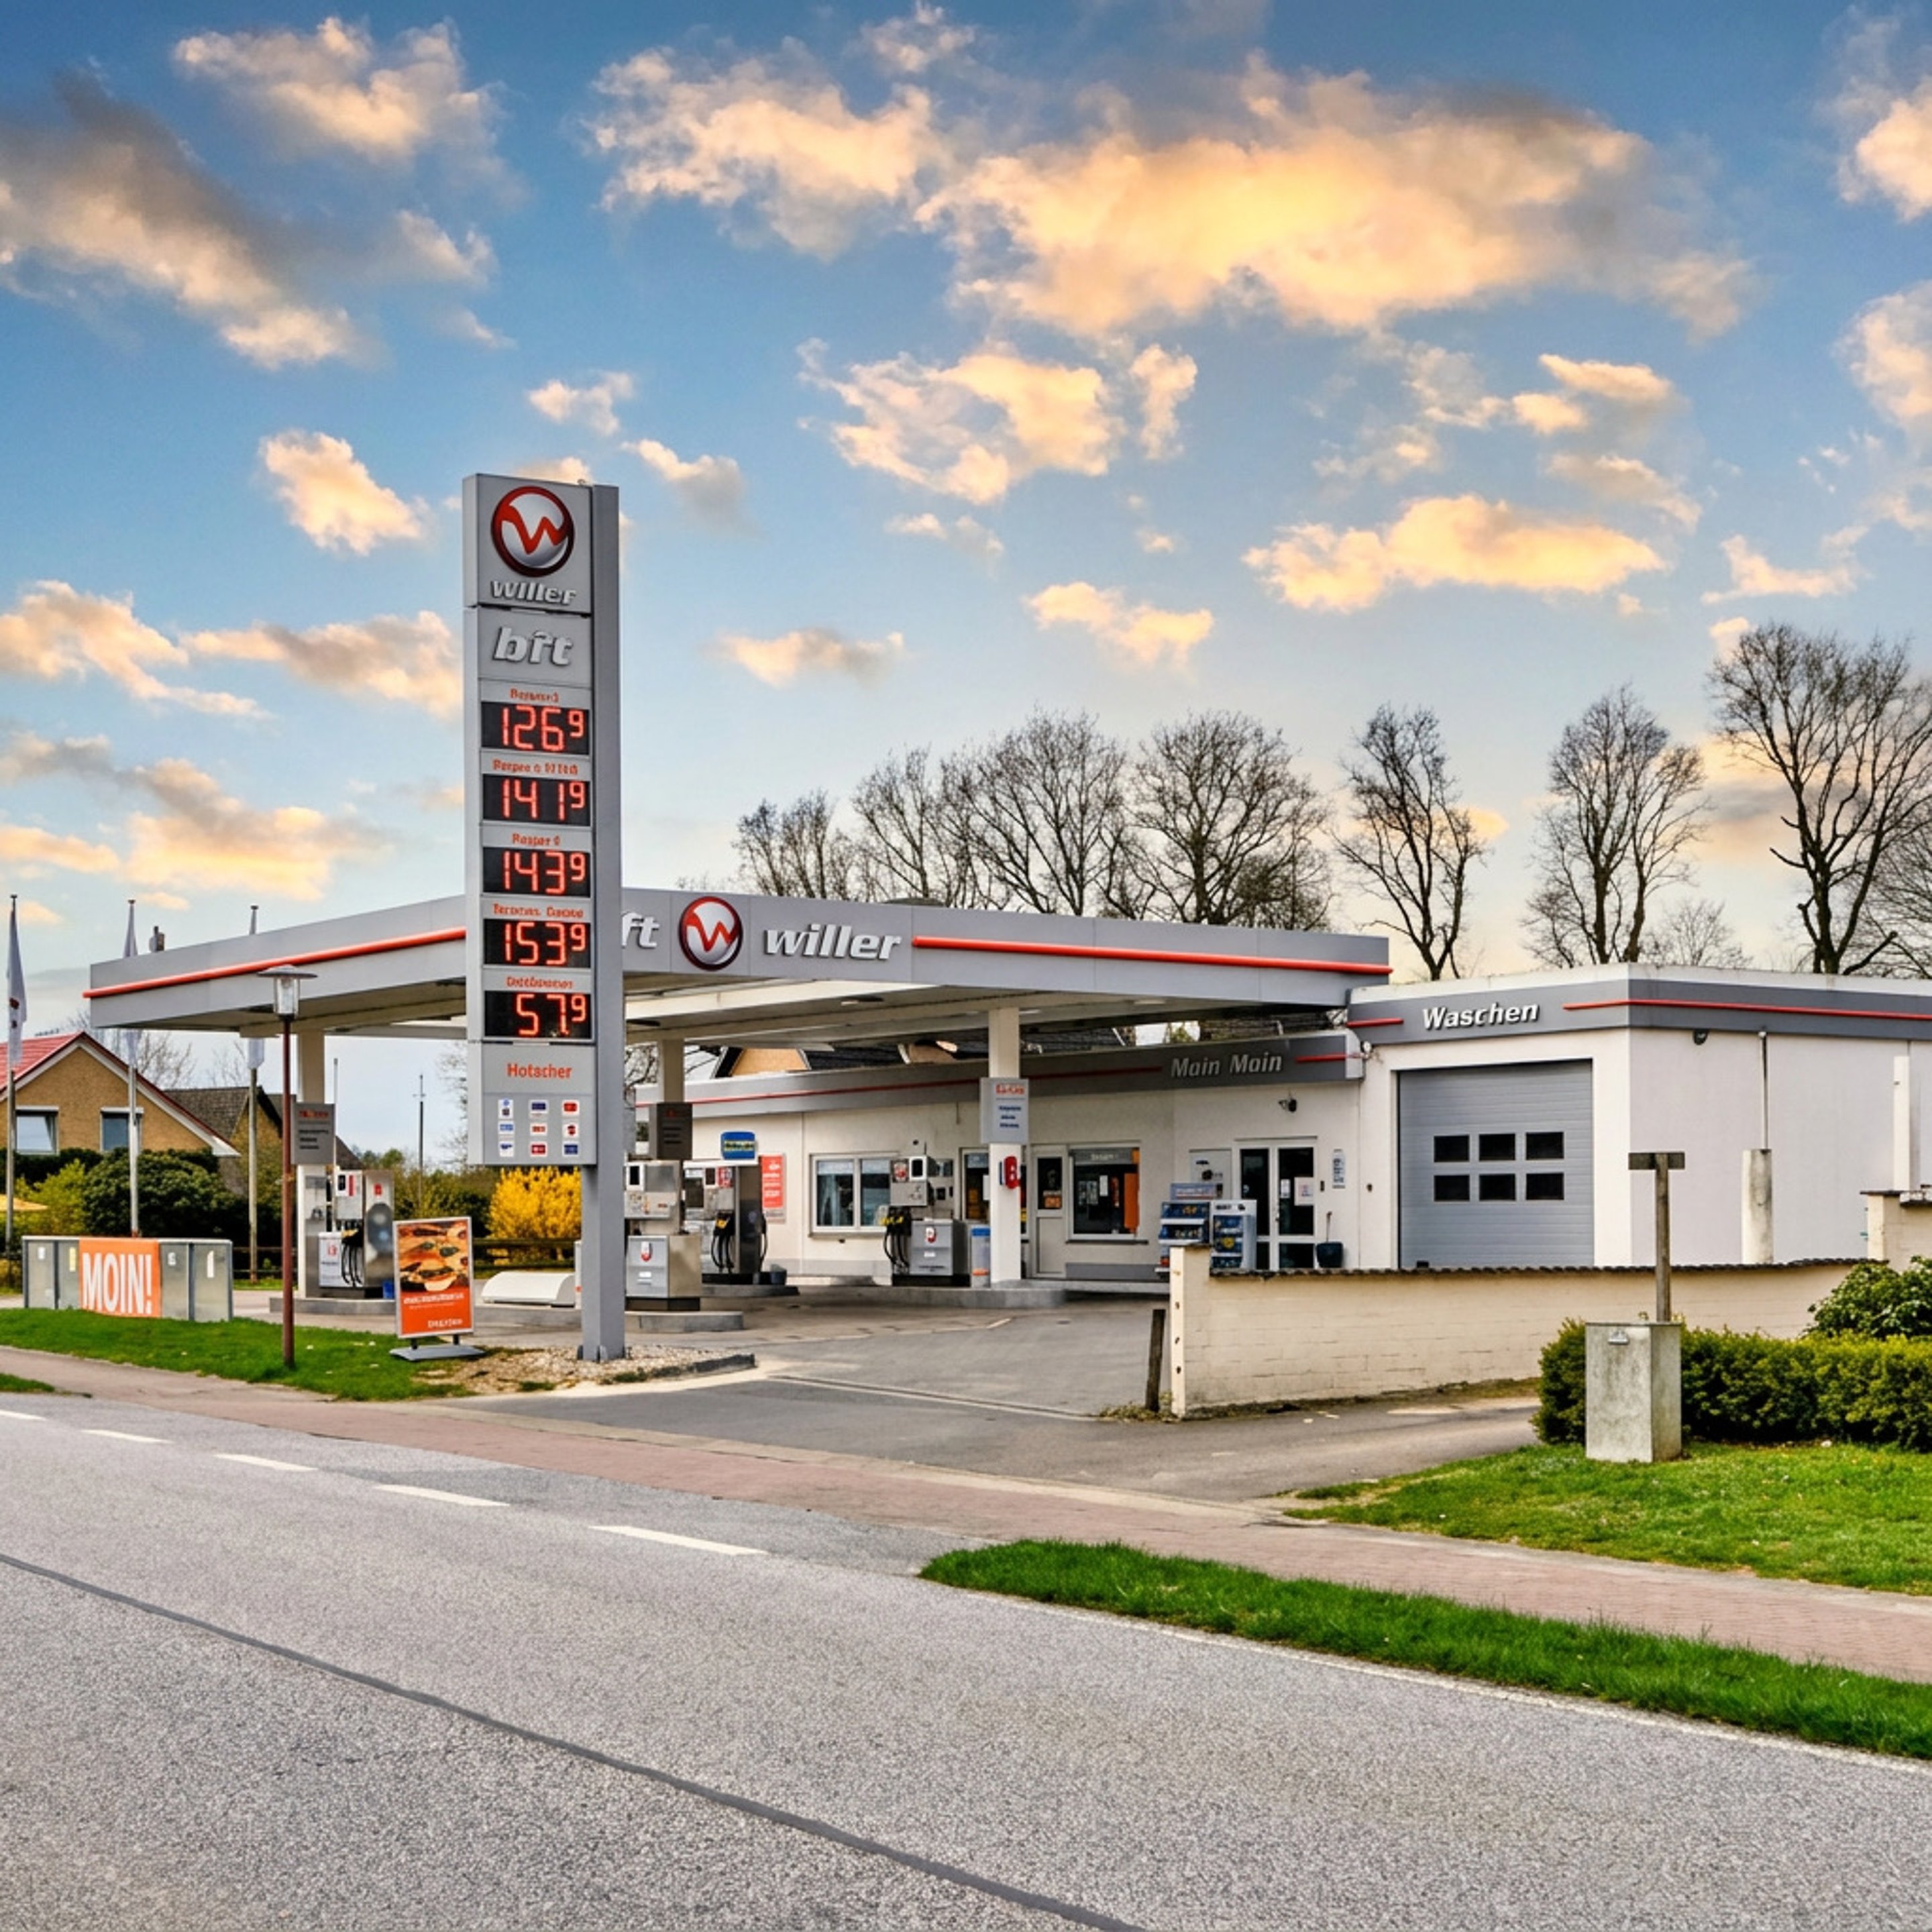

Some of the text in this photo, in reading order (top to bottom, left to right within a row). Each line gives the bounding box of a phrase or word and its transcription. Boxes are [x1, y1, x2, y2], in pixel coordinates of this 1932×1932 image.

[622, 910, 660, 949] ft
[764, 923, 902, 961] willer
[1422, 1002, 1540, 1030] Waschen
[82, 1252, 152, 1316] MOIN!
